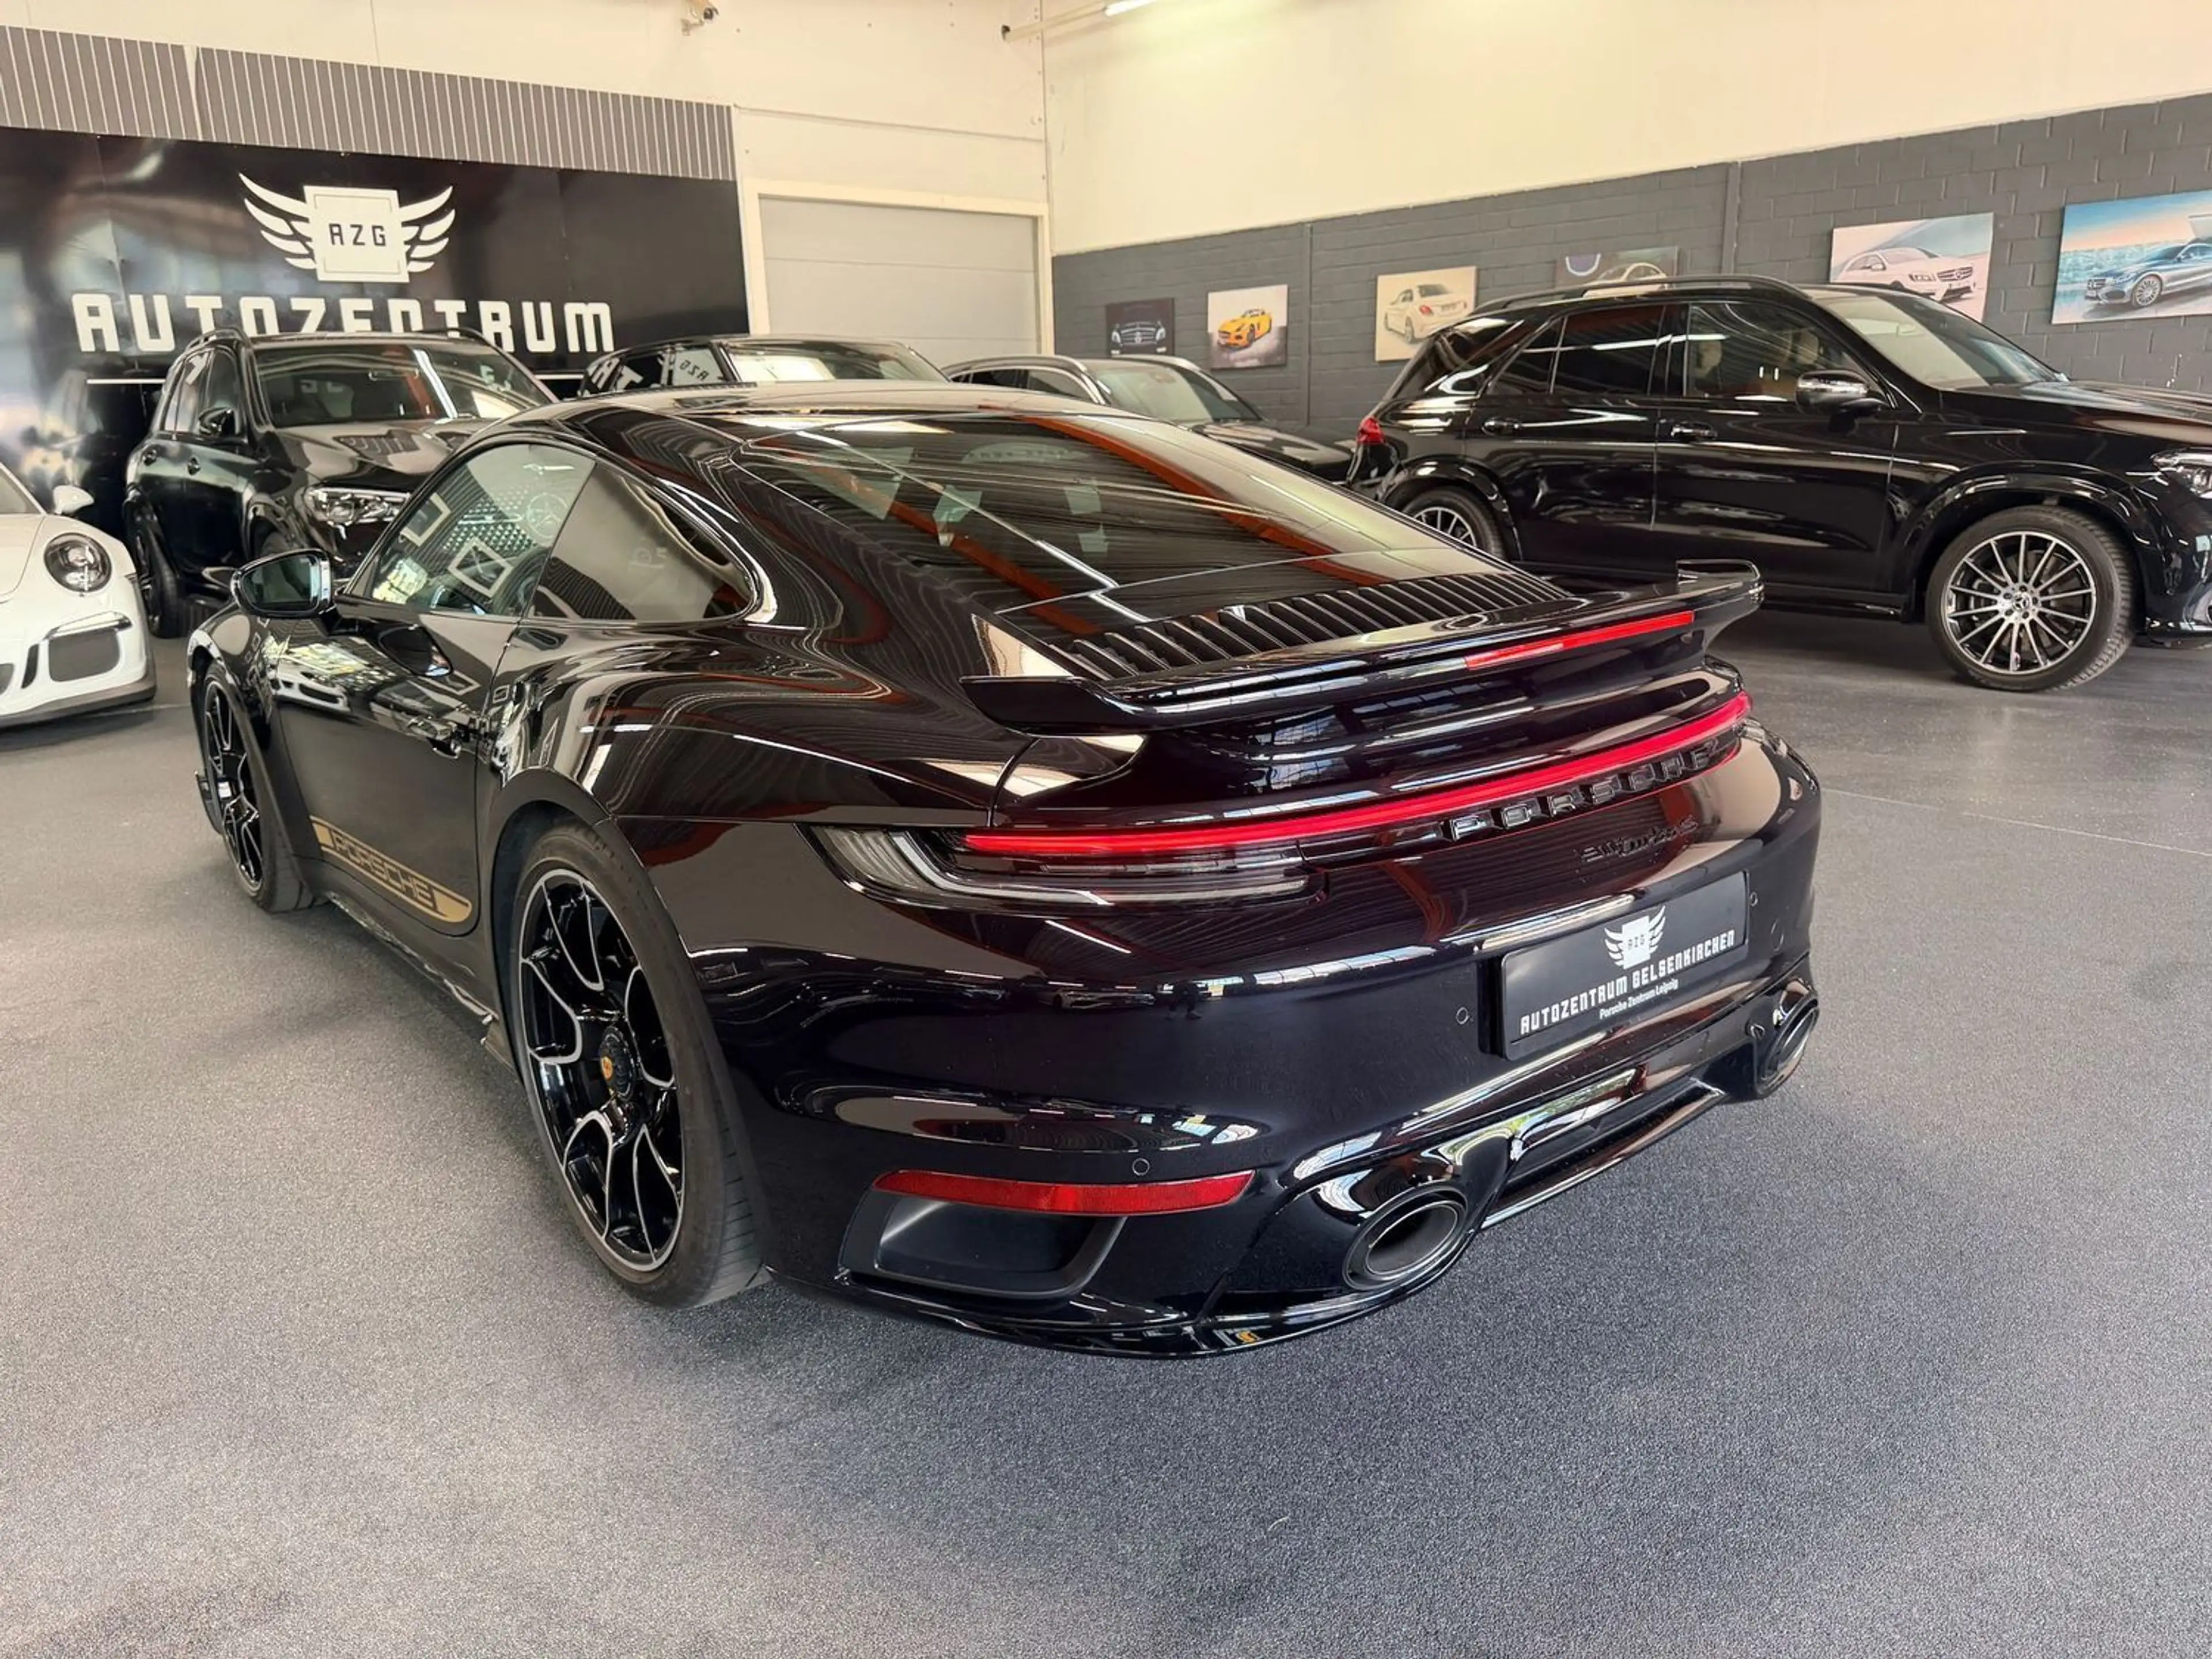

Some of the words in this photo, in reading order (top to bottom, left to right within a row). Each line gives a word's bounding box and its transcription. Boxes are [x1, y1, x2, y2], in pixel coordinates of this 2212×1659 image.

[328, 223, 386, 247] AZG
[1449, 743, 1715, 842] PORSCHE
[331, 828, 435, 909] PORSCHE
[1520, 976, 1627, 1036] AUTOZENTRUM
[1633, 929, 1736, 988] GELSENKIRCHEN
